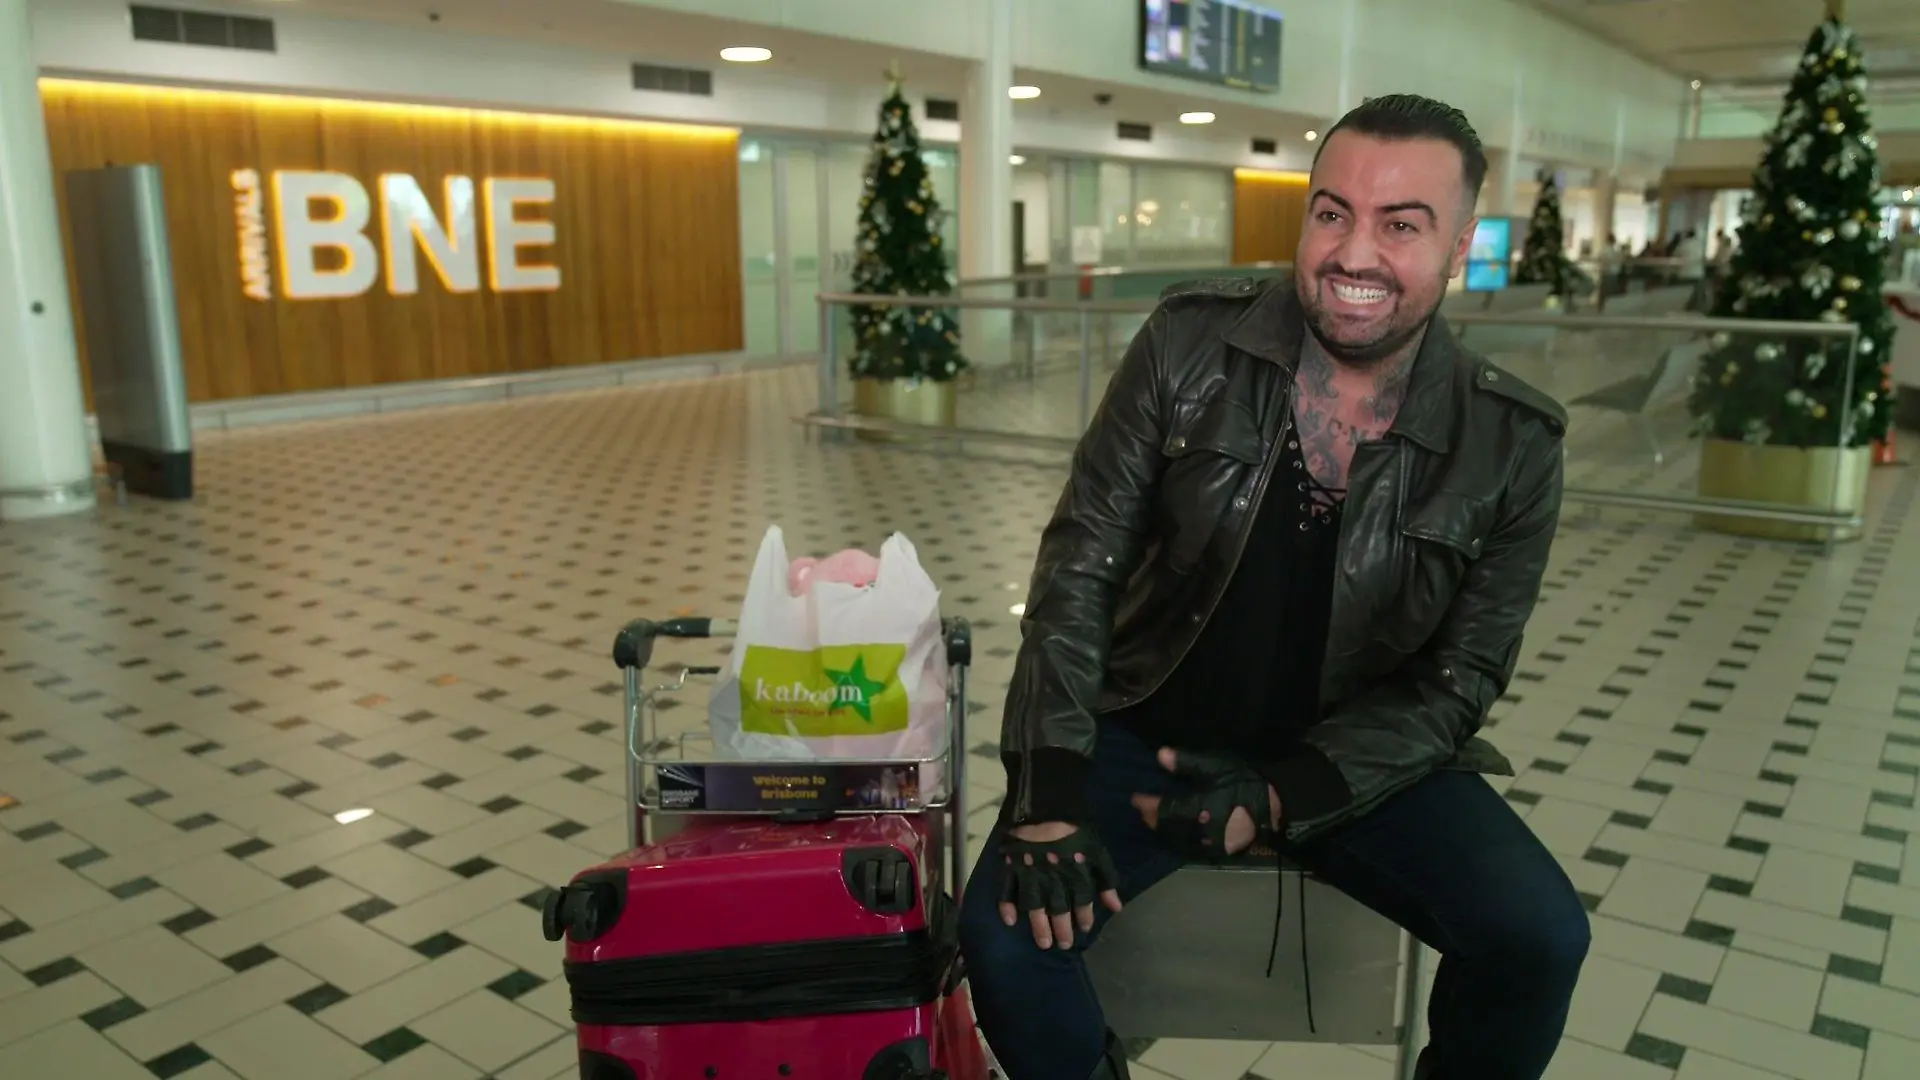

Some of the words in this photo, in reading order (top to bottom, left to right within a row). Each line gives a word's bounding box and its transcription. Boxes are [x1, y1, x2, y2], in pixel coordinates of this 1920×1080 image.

[271, 169, 561, 299] BNE
[755, 677, 863, 706] kaboom
[753, 775, 809, 786] Welcome
[812, 775, 827, 786] to
[761, 788, 818, 799] Brisbane
